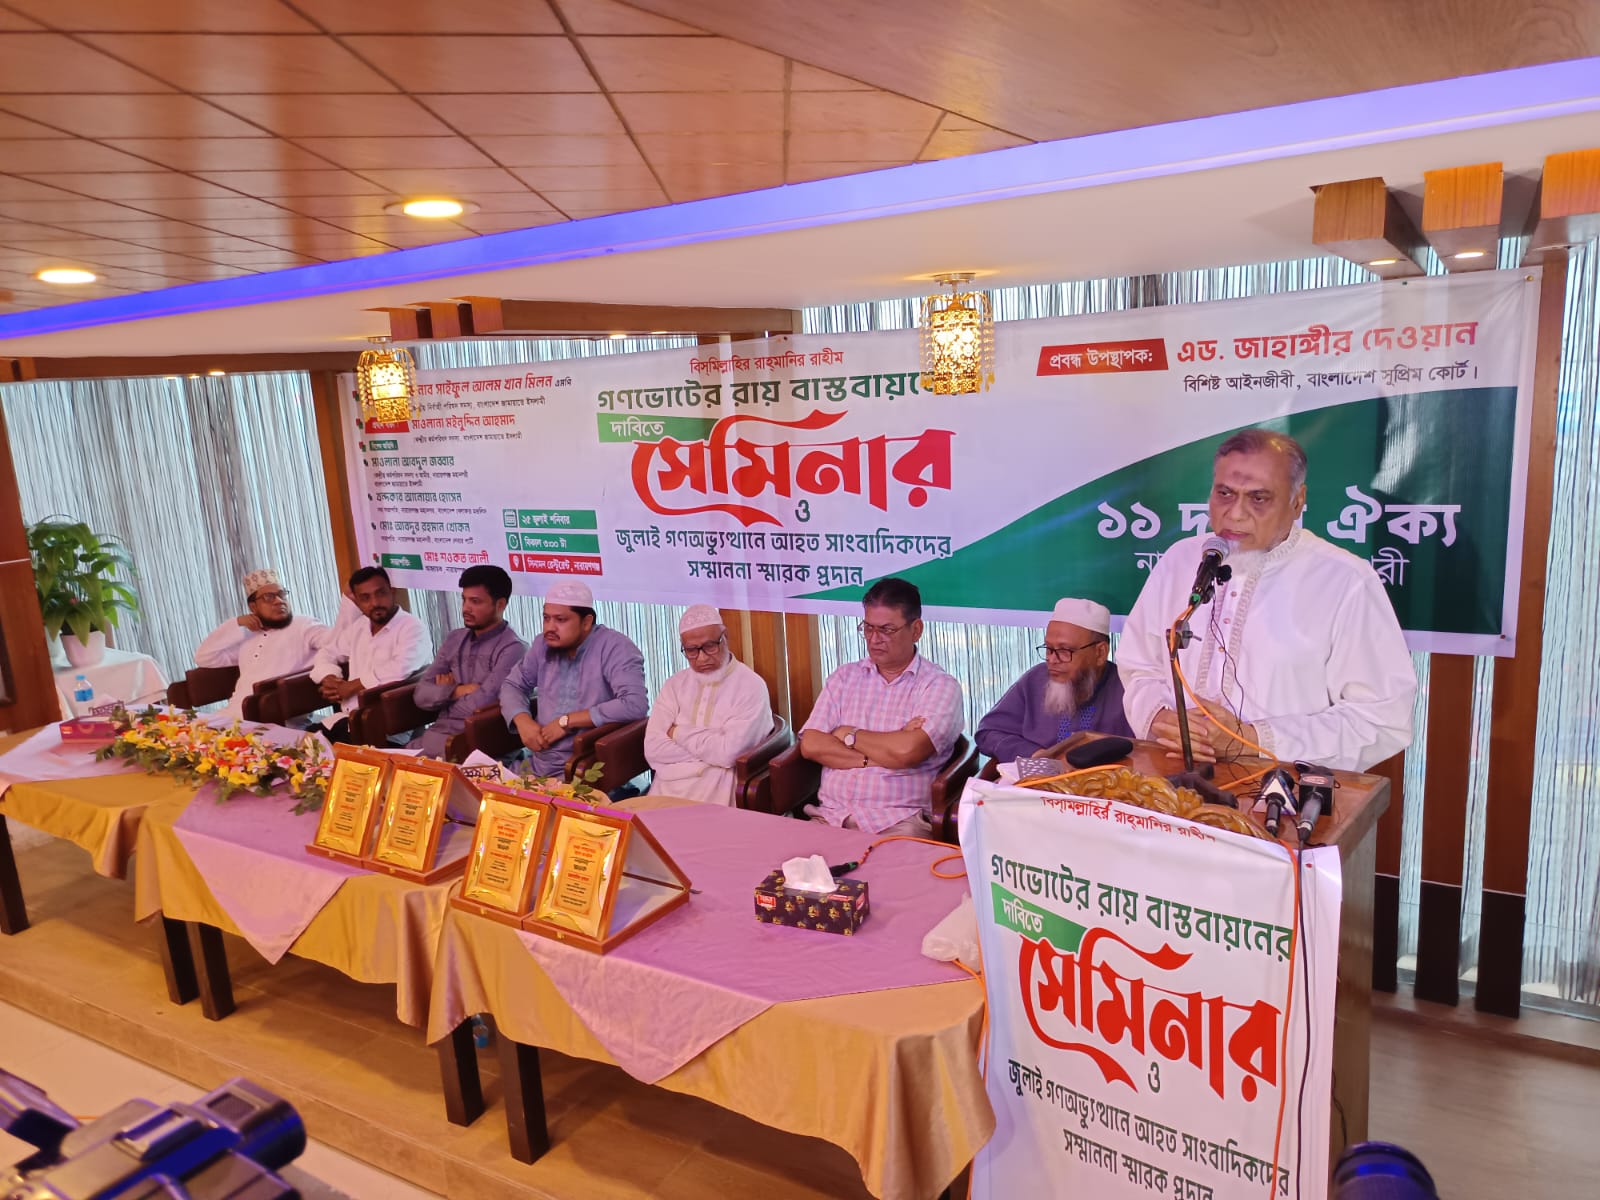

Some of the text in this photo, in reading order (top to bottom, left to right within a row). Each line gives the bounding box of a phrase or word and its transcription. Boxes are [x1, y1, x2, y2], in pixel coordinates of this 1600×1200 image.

[1177, 322, 1478, 362] এড. জাহাঙ্গীর দেওয়ান
[810, 351, 844, 367] রাহীম
[1050, 353, 1082, 369] প্রবন্ধ
[436, 380, 469, 398] সাইফুল
[472, 379, 501, 393] আলম
[504, 378, 522, 390] খান
[525, 373, 553, 389] মিলন
[1184, 373, 1221, 392] বিশিষ্ট
[1307, 370, 1375, 388] বাংলাদেশ
[1381, 364, 1422, 386] সুপ্রিম
[599, 379, 721, 410] গণভোটের
[731, 381, 780, 407] রায়
[412, 418, 444, 430] মাওলানা
[610, 416, 664, 437] দাবিতে
[371, 456, 400, 467] মাওলানা
[631, 409, 957, 528] সেমিনার
[795, 499, 811, 523] ও
[1097, 501, 1161, 539] ১১
[1327, 485, 1461, 547] ঐক্য
[421, 522, 444, 532] রহমান
[615, 525, 952, 558] জুলাই গণঅভ্যুত্থানে আহত সাংবাদিকদের
[468, 550, 489, 563] আলী
[687, 560, 864, 586] সম্মাননা স্মারক প্রদান
[991, 853, 1293, 962] গণভোটের রায় বাস্তবায়নের
[1002, 896, 1044, 933] দাবিতে
[1019, 927, 1282, 1103] সেমিনার
[1148, 1062, 1161, 1093] ও
[1008, 1058, 1290, 1197] জুলাই গণঅভ্যুত্থানে আহত সাংবাদিকদের
[1063, 1127, 1118, 1174] সম্মাননা
[1121, 1153, 1168, 1193] স্মারক
